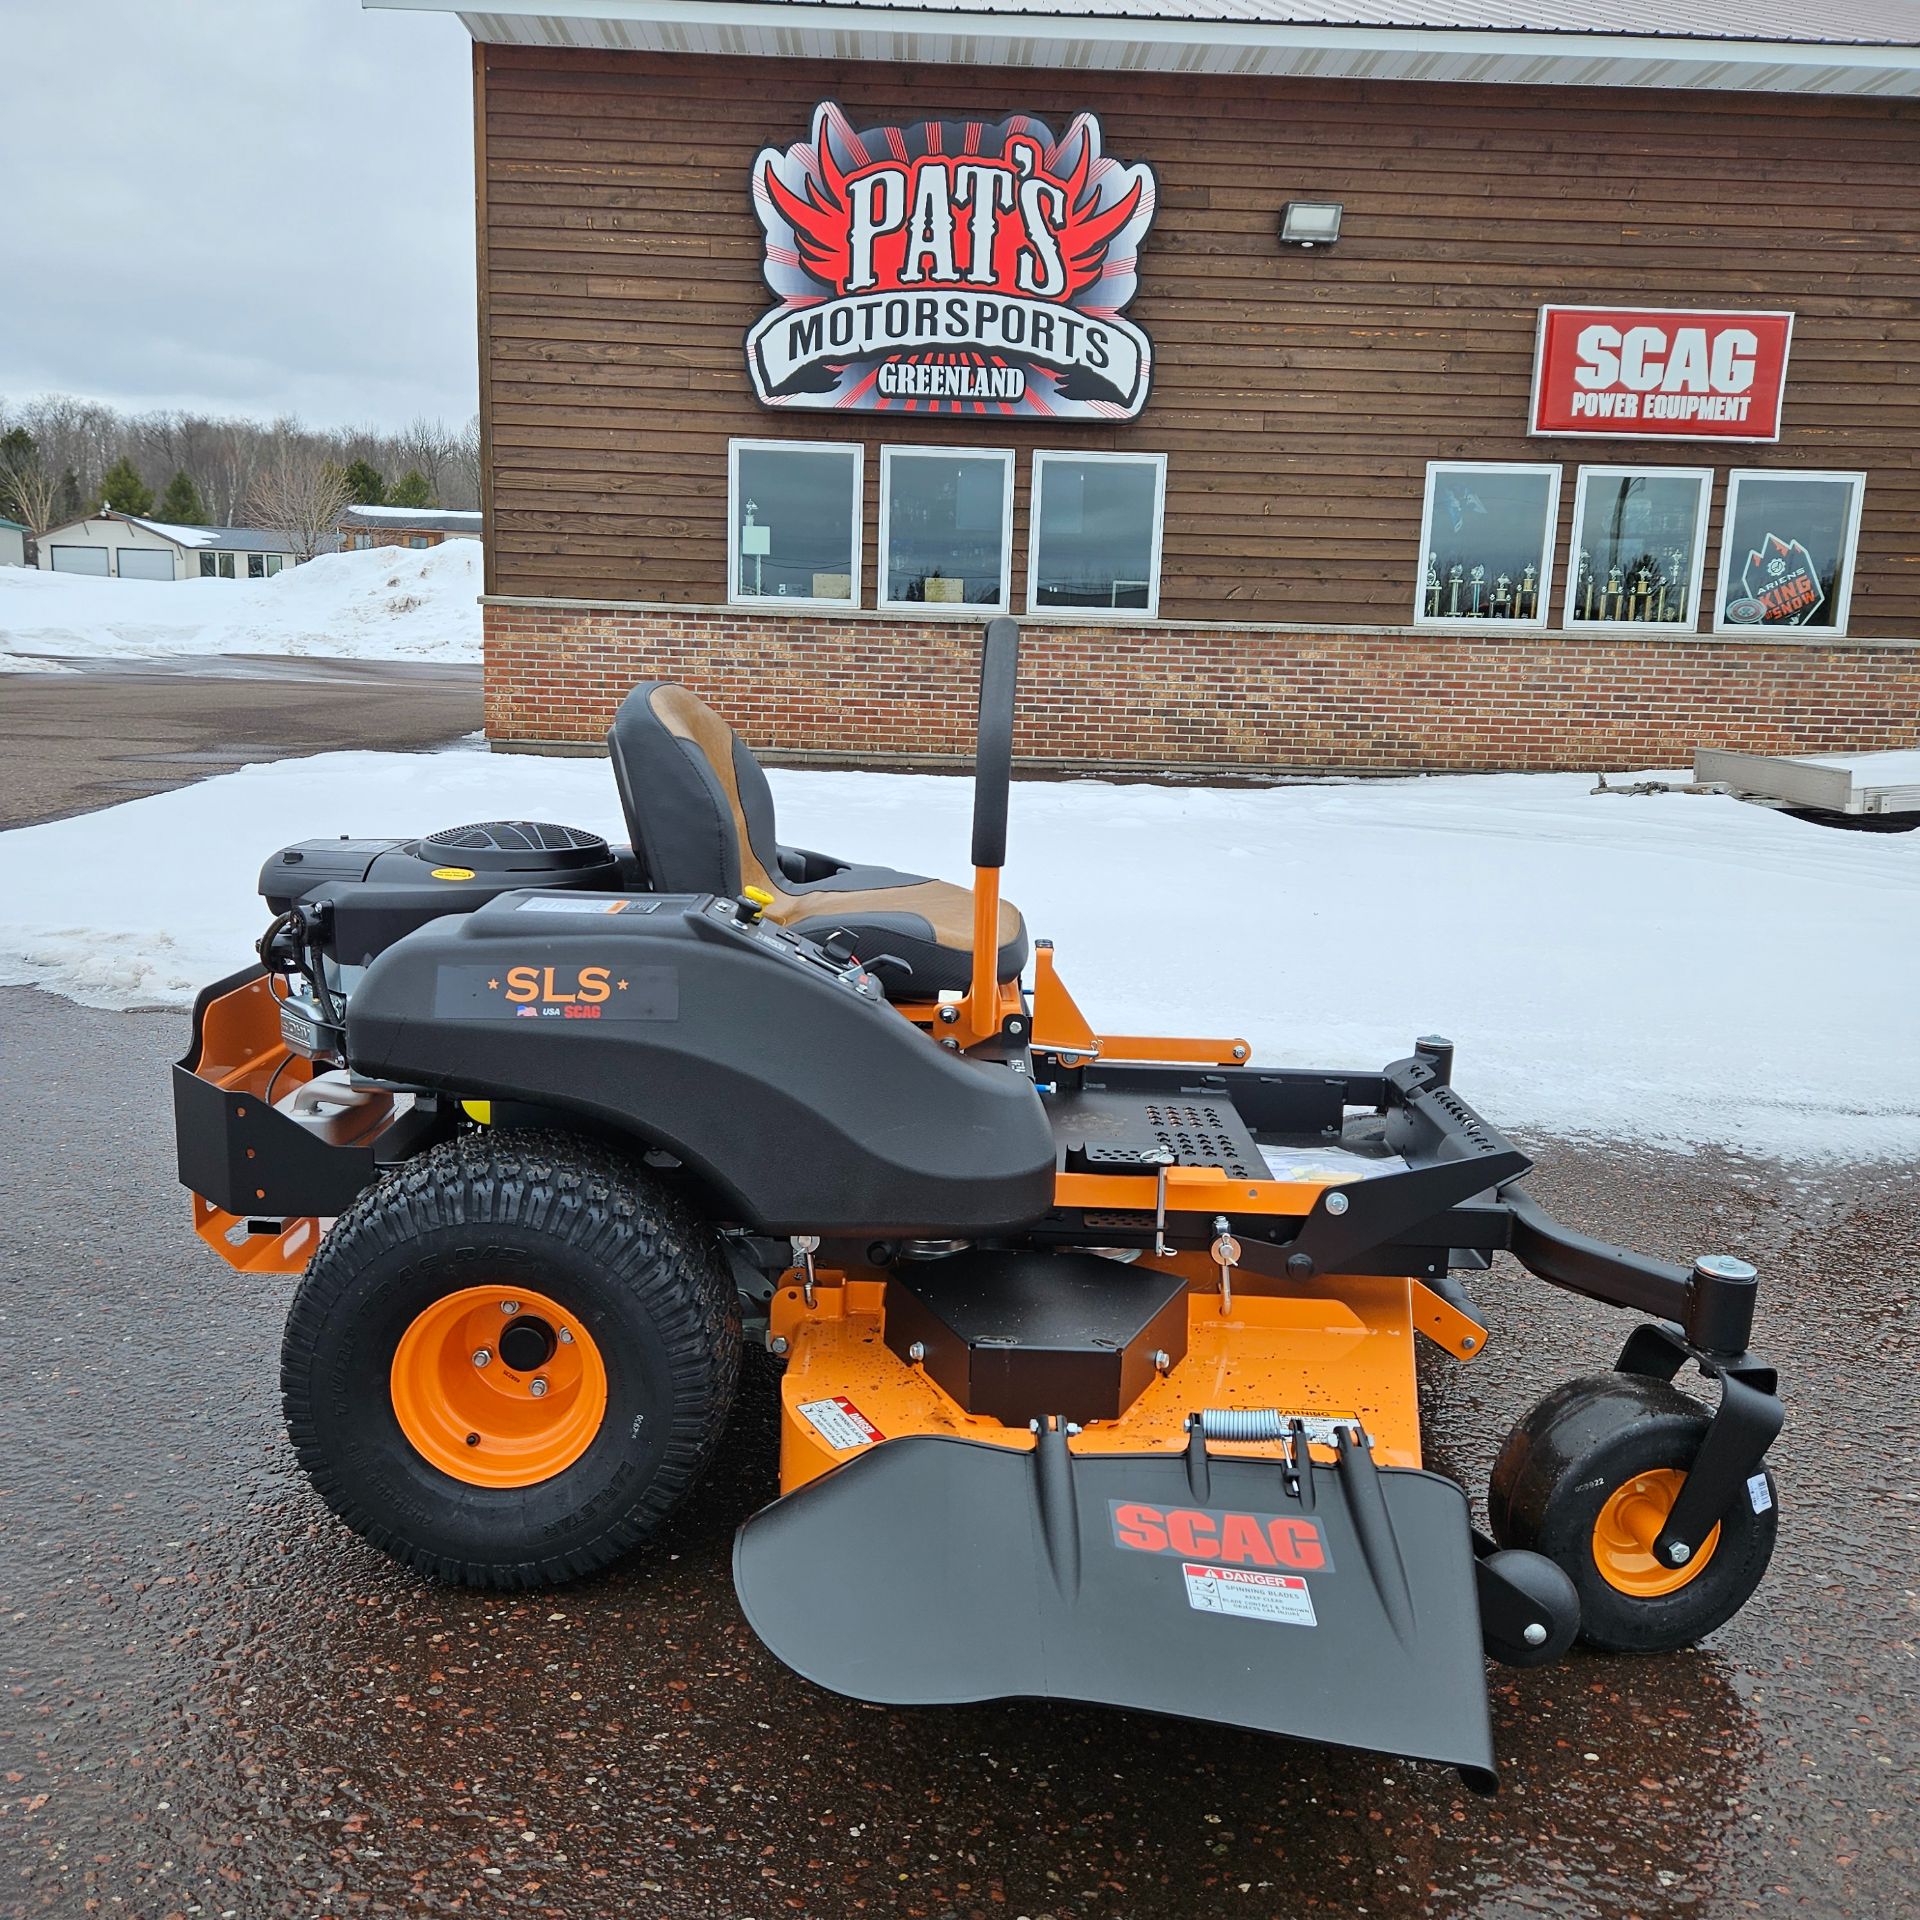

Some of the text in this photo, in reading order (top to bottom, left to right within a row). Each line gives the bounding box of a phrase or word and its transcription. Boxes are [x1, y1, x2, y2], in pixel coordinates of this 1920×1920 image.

[846, 144, 1067, 297] PAT'S
[788, 299, 1110, 369] MOTORSPORTS
[1573, 324, 1759, 394] SCAG
[878, 363, 1025, 399] GREENLAND
[1571, 391, 1751, 421] POWER EQUIPMENT
[1757, 567, 1806, 596] ARIENS
[1758, 575, 1812, 609] KING
[1772, 590, 1816, 620] SNOW
[505, 966, 611, 1003] SLS
[543, 1005, 602, 1019] USA SCAG
[848, 1412, 877, 1434] DANGER
[1115, 1503, 1326, 1570] SCAG
[1222, 1571, 1287, 1587] DANGER
[1225, 1585, 1300, 1600] SPINNING BLADES
